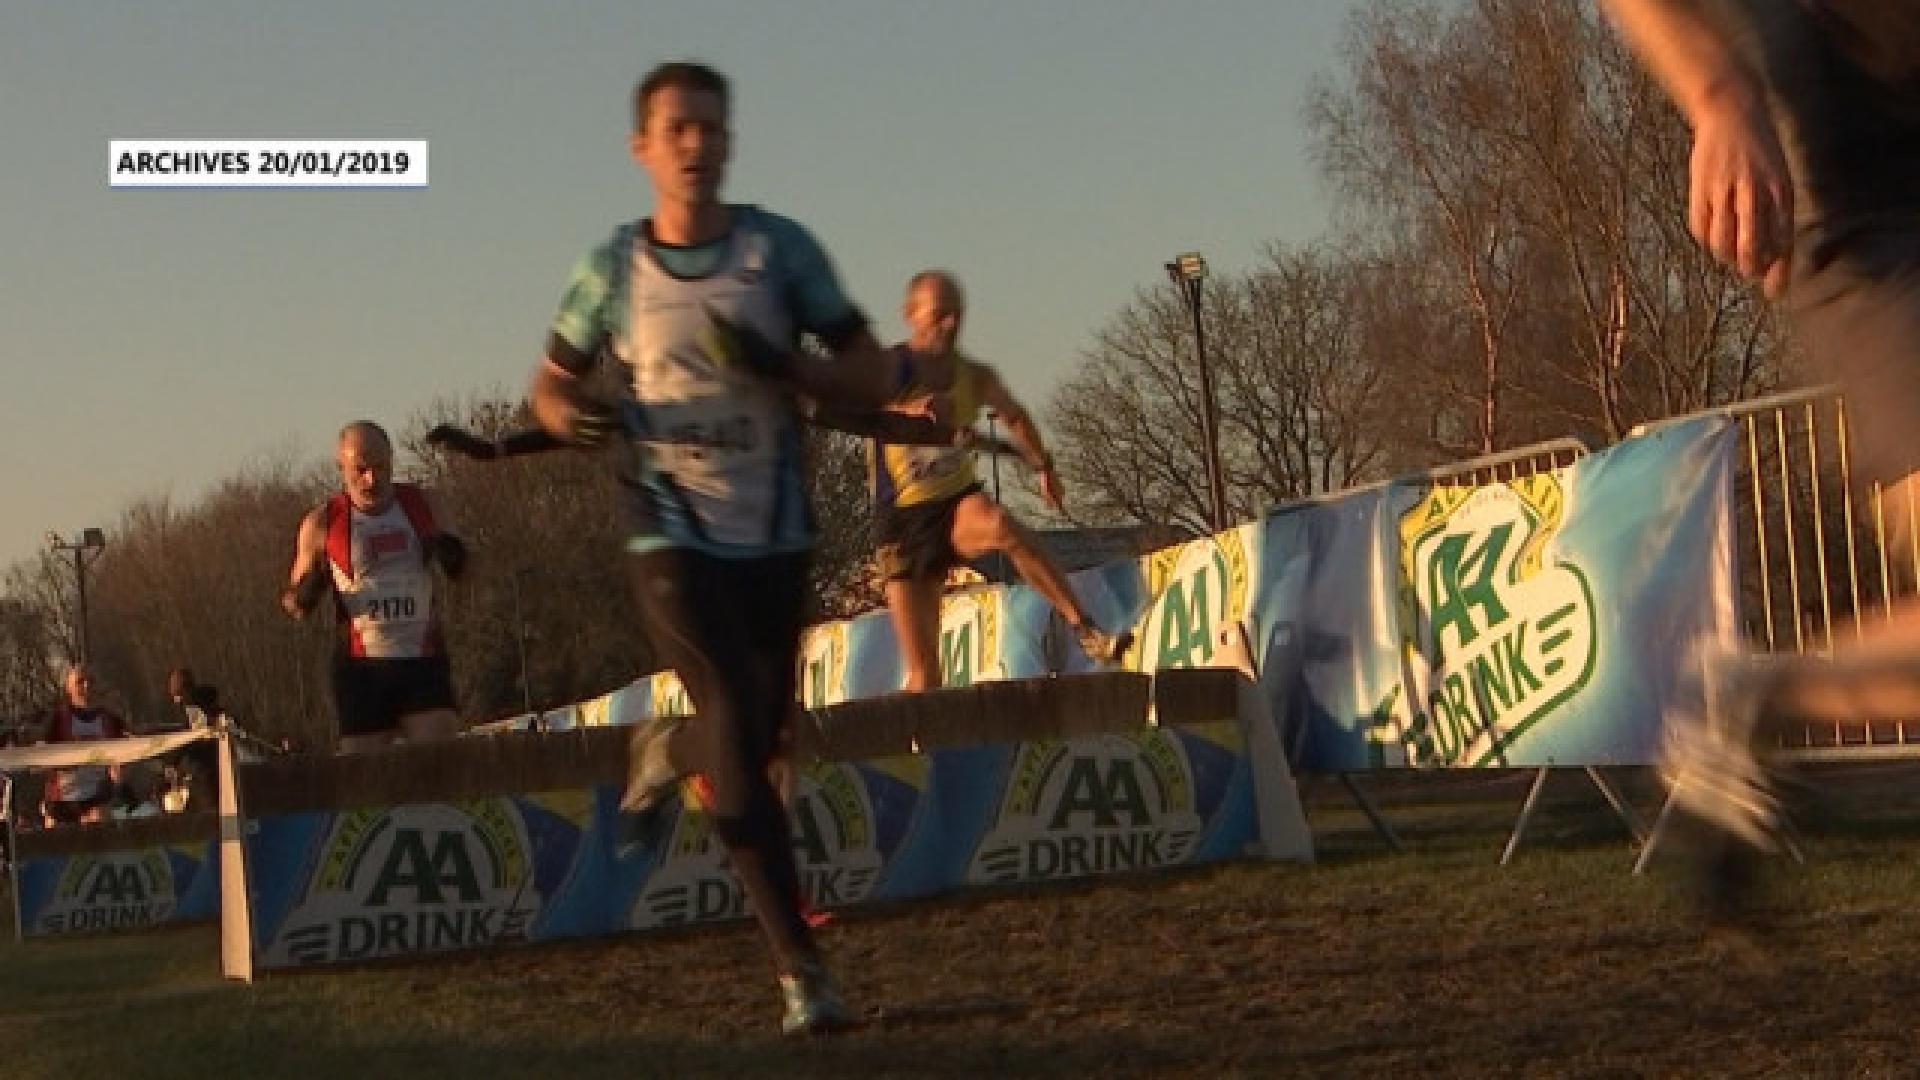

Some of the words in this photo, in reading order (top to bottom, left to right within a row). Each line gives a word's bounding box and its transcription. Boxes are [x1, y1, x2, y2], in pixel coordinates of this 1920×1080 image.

[1431, 521, 1511, 672] AA
[1430, 620, 1544, 765] DRINK
[1048, 758, 1153, 831] AA
[86, 863, 146, 904] AA
[362, 829, 481, 906] AA
[1027, 831, 1164, 876] DRINK
[337, 908, 496, 959] DRINK
